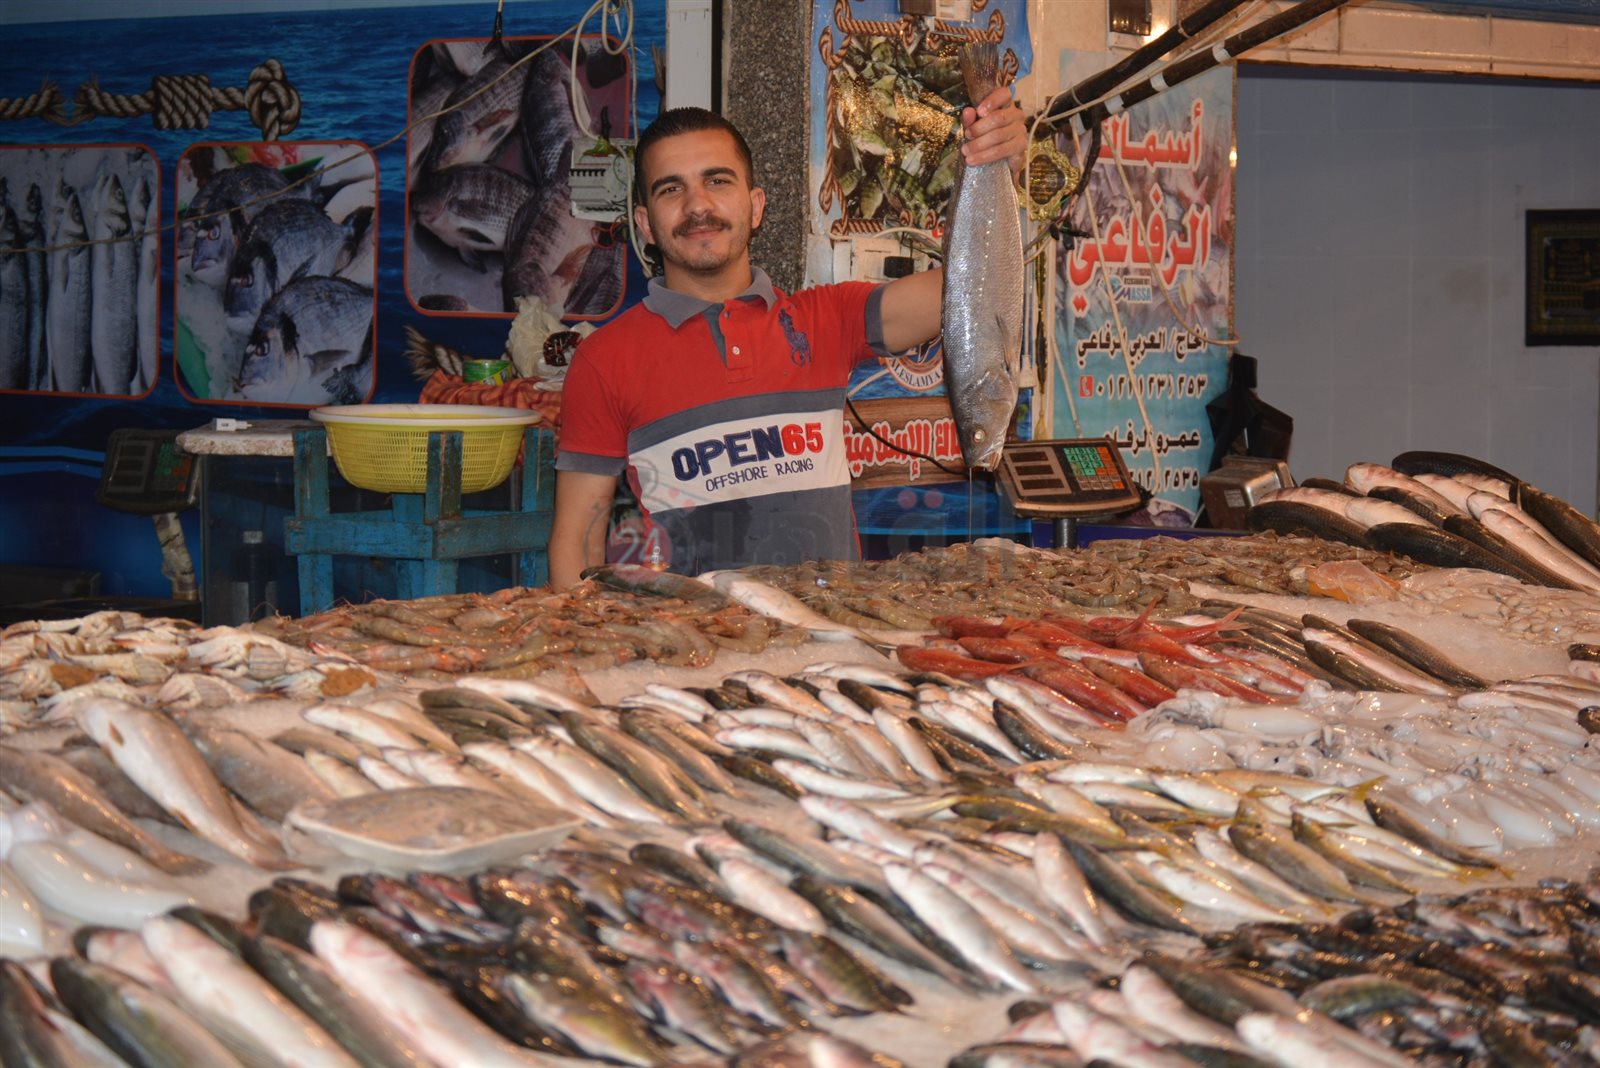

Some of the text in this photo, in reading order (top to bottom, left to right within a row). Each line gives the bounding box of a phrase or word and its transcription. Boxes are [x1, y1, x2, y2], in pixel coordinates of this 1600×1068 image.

[1069, 184, 1211, 314] الرفاعي
[706, 458, 814, 492] OFFSHORE RACING
